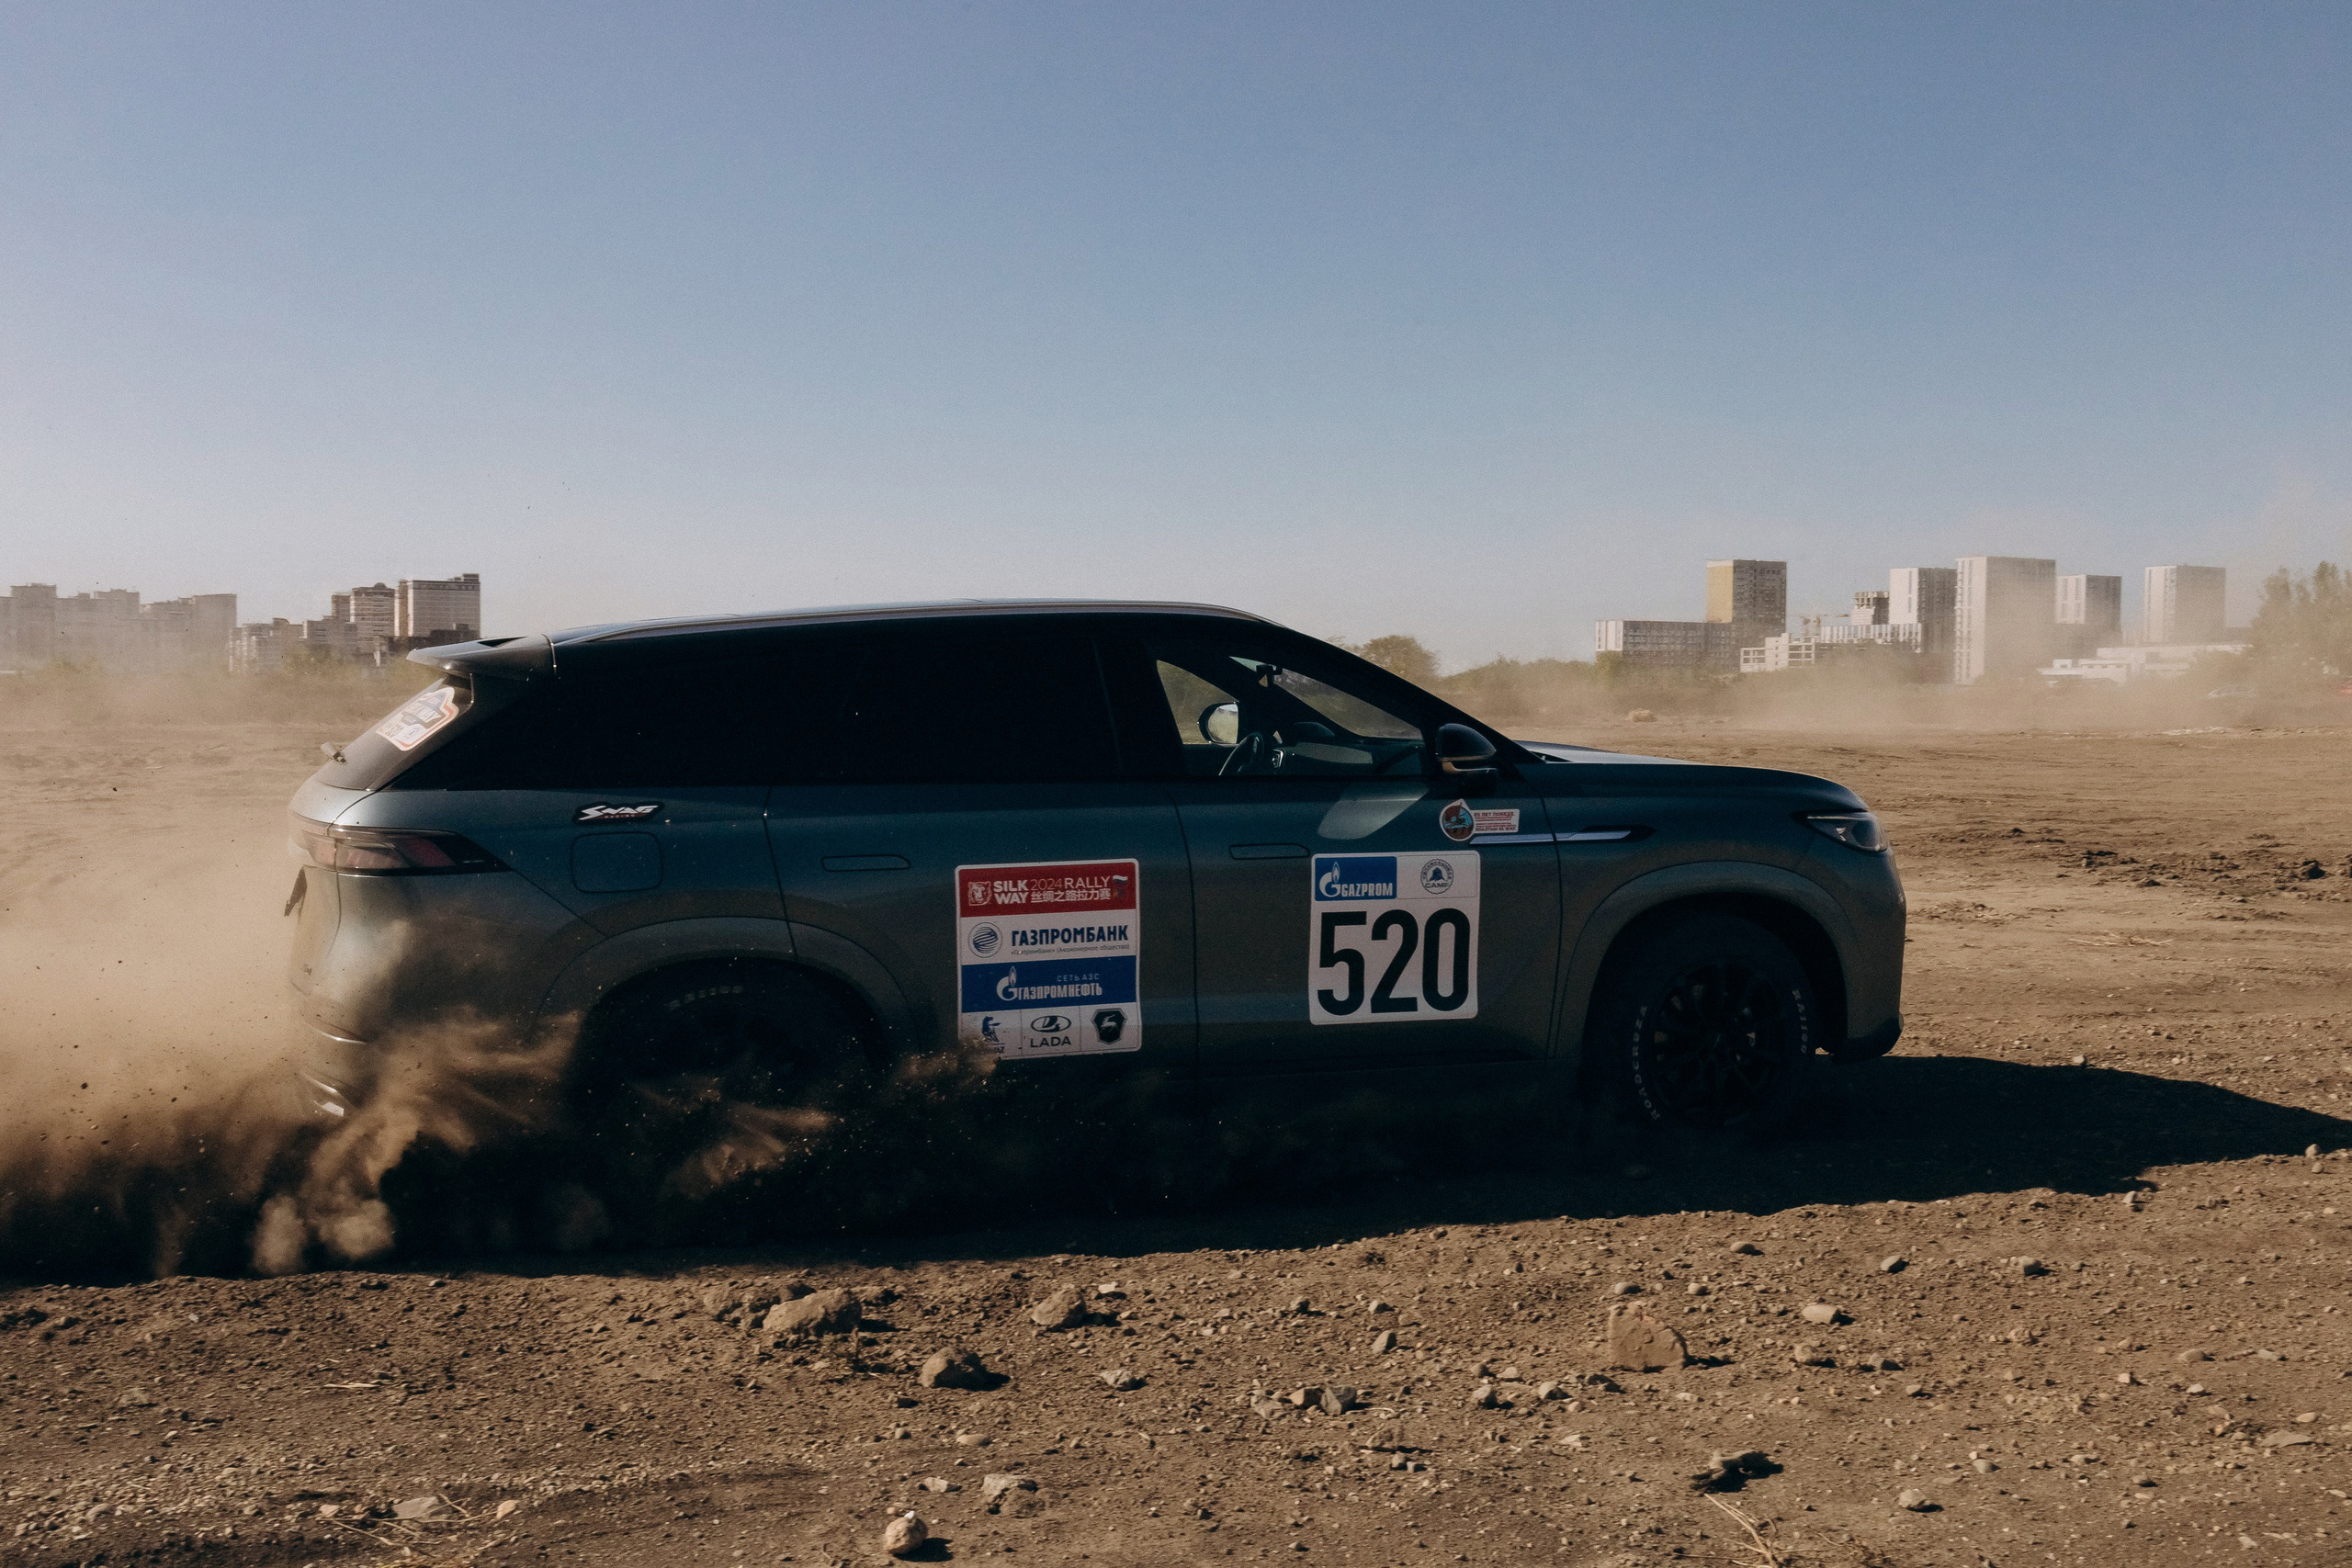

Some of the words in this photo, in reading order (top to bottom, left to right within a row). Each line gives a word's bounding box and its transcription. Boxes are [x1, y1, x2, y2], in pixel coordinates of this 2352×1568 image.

[993, 879, 1029, 892] SILK
[1030, 878, 1063, 891] 2024
[1064, 875, 1111, 889] RALLY
[1340, 882, 1394, 897] GAZPROM
[994, 891, 1028, 905] WAY
[1031, 888, 1111, 903] 丝绸之路拉力赛
[1012, 925, 1129, 947] ГАЗПРОМБАНК
[1317, 908, 1471, 1016] 520
[1082, 973, 1101, 981] АЗС
[1017, 982, 1103, 1000] ГАЗПРОМНЕФТЬ
[1030, 1035, 1072, 1048] LADA
